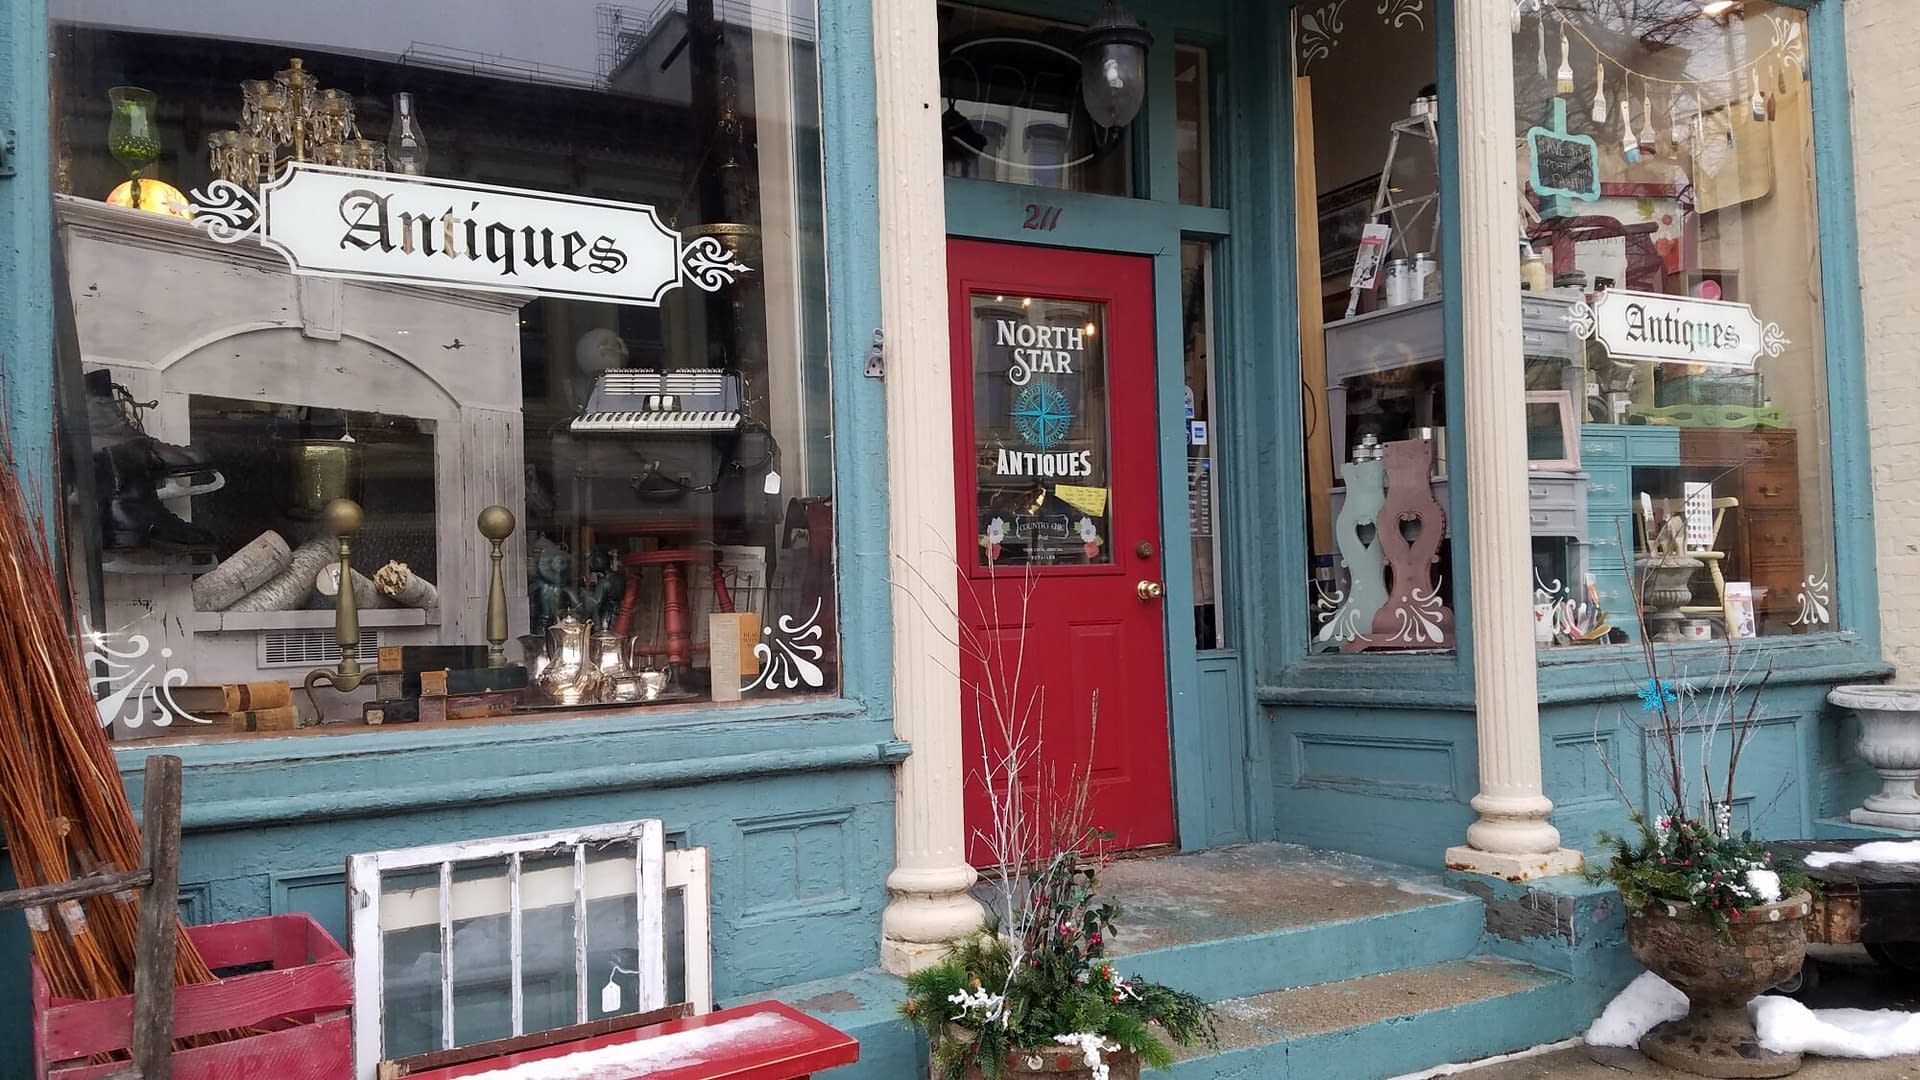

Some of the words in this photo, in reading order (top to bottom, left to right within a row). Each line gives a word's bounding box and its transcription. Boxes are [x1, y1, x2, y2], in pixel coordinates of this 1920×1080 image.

[339, 189, 628, 276] Antiques
[1023, 203, 1063, 232] 211
[996, 319, 1085, 351] NORTH
[1625, 303, 1741, 353] Antiques
[1009, 347, 1074, 386] STAR
[996, 448, 1092, 477] ANTIQUES
[1019, 521, 1049, 531] COUNTRY
